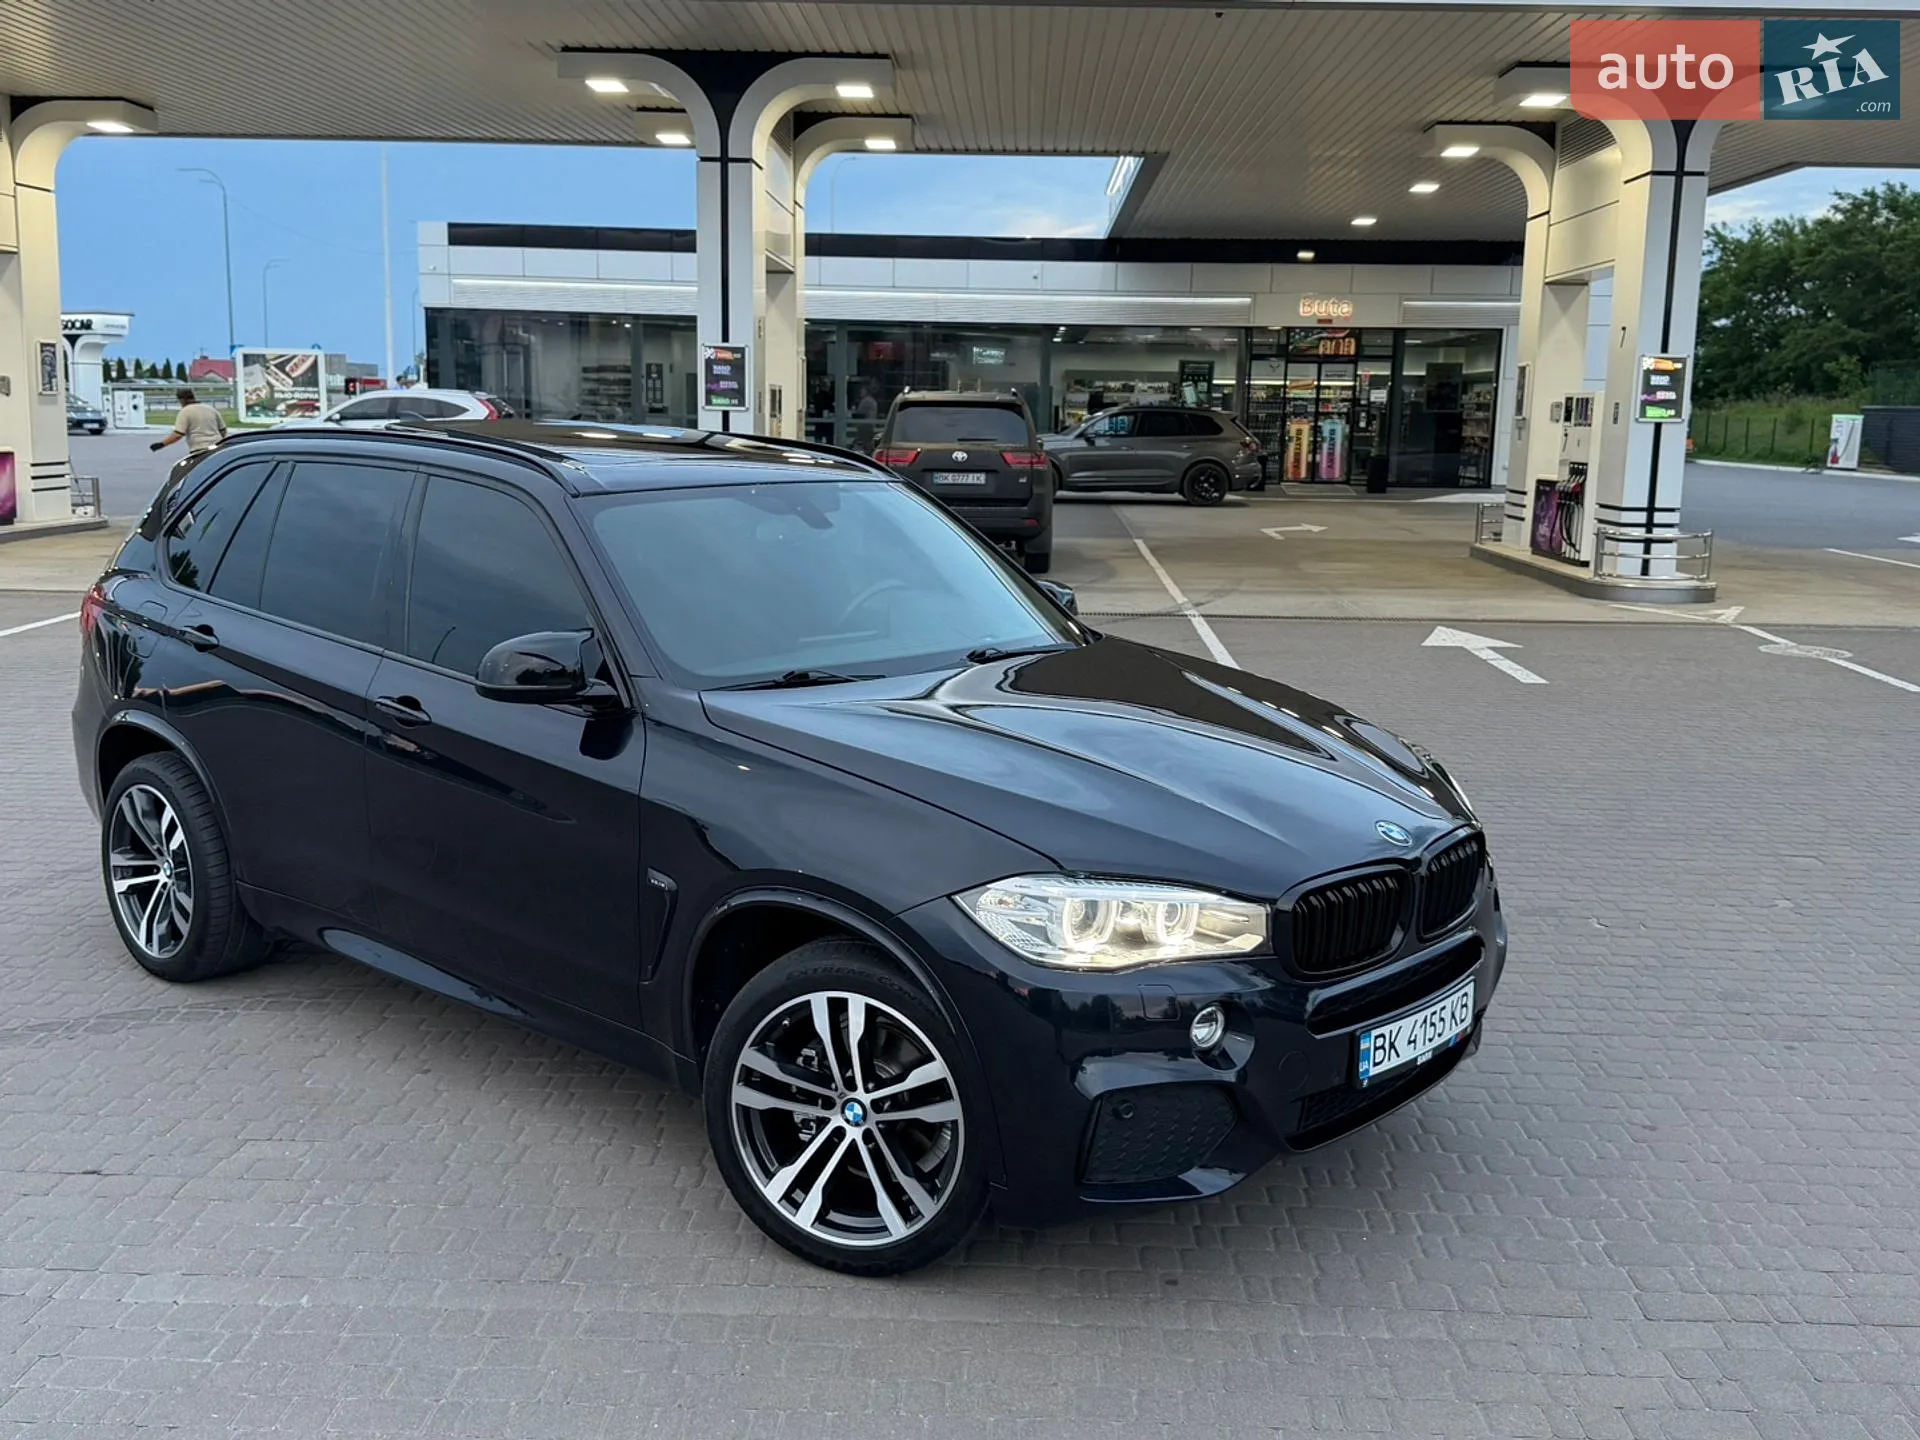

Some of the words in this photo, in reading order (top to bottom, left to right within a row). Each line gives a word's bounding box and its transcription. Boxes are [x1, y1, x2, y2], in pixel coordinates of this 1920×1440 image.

[1299, 296, 1353, 316] Buta
[1372, 1025, 1402, 1067] BK
[1406, 1005, 1446, 1051] 4155
[1449, 991, 1469, 1031] KB
